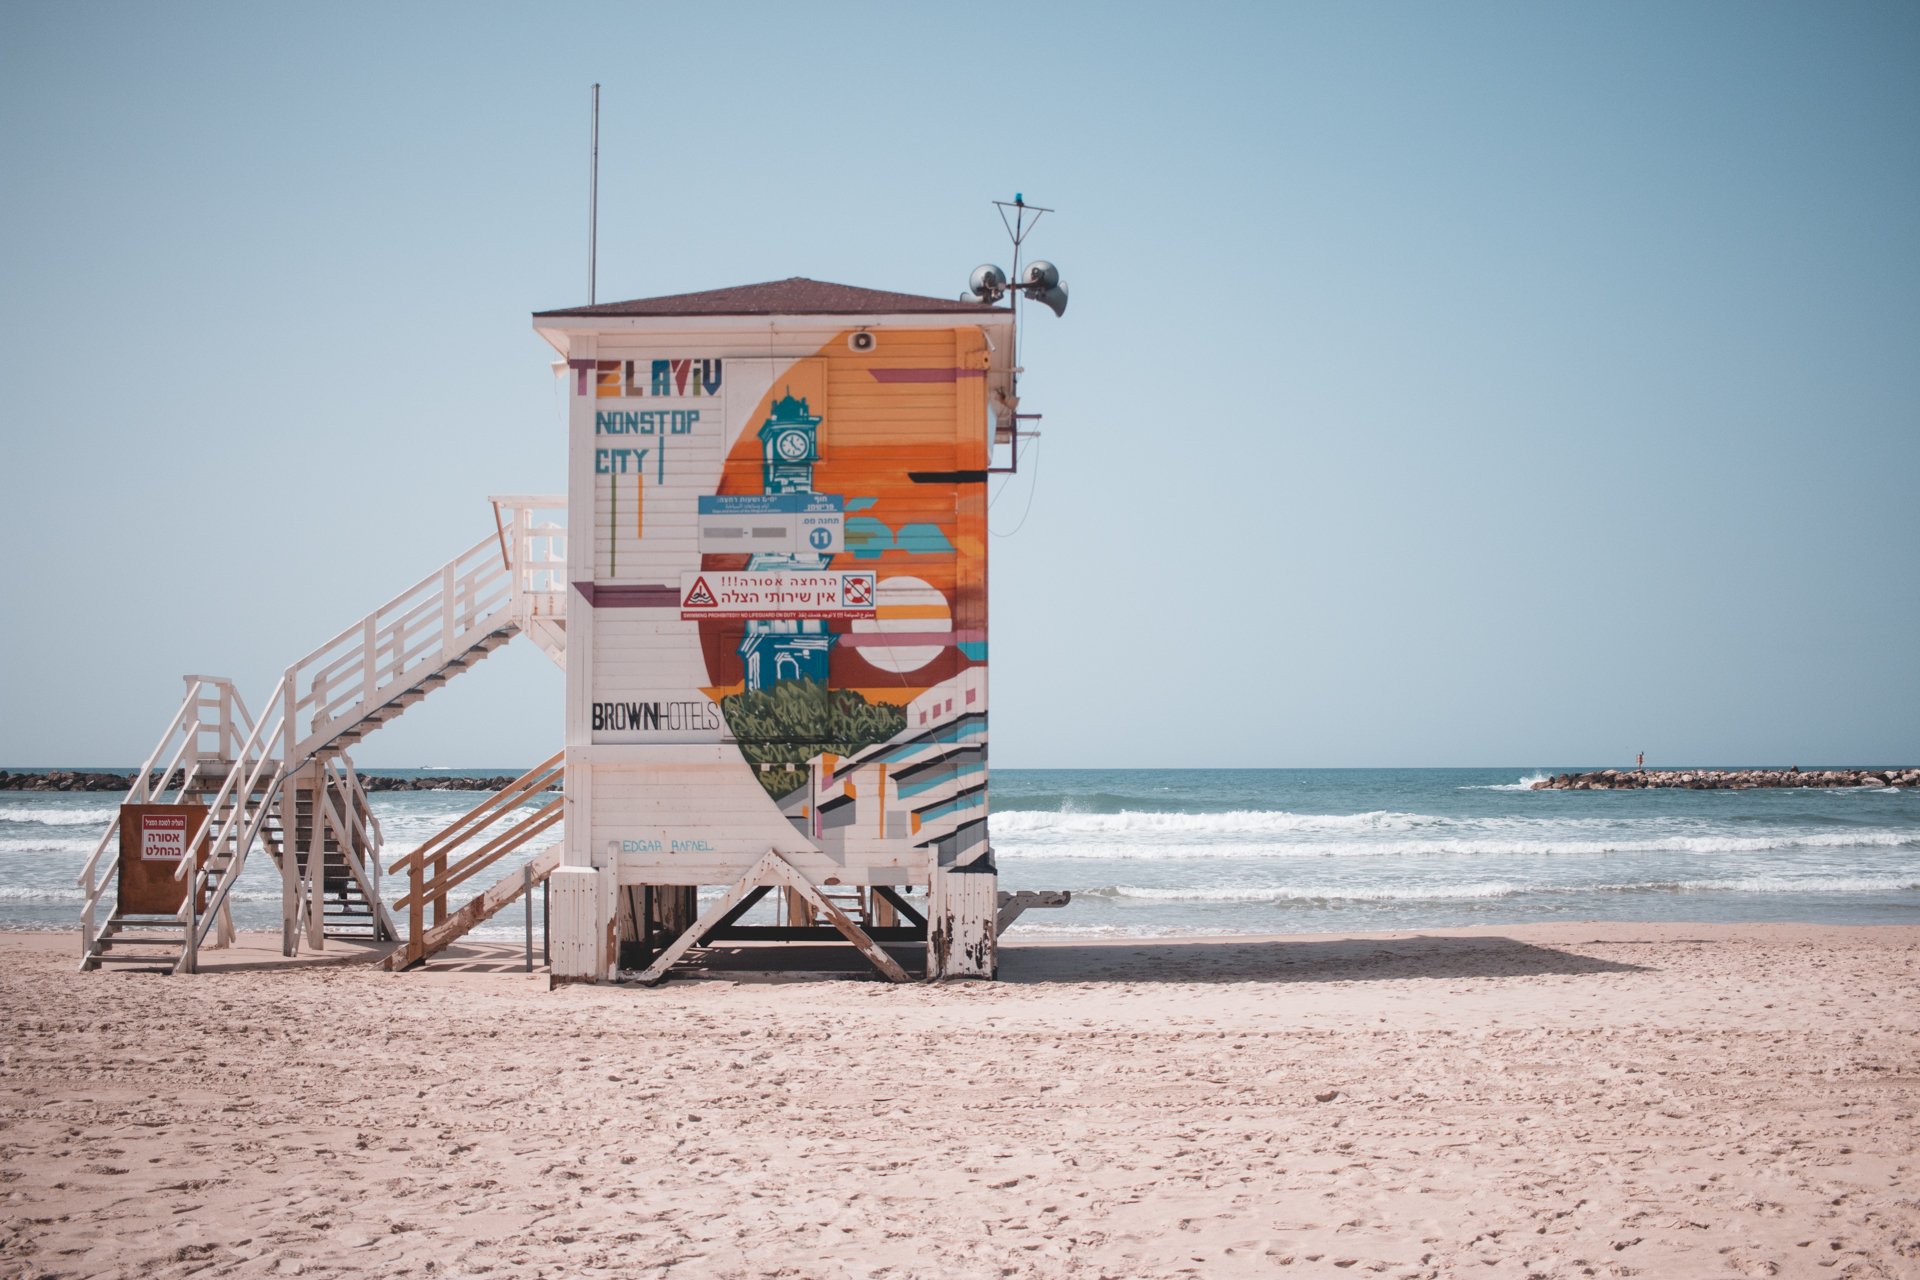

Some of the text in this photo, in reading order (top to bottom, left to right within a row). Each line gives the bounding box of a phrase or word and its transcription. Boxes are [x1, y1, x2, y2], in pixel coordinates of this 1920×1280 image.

[570, 359, 643, 397] TEL
[596, 410, 700, 434] NONSTOP
[596, 449, 649, 473] CITY
[814, 496, 828, 504] חוף
[811, 532, 829, 545] 11
[790, 577, 837, 586] הרחצה
[721, 590, 836, 606] אין שירותי הצלה
[148, 833, 180, 842] אסורה
[146, 845, 181, 856] בהחלט
[623, 840, 662, 852] EDGAR
